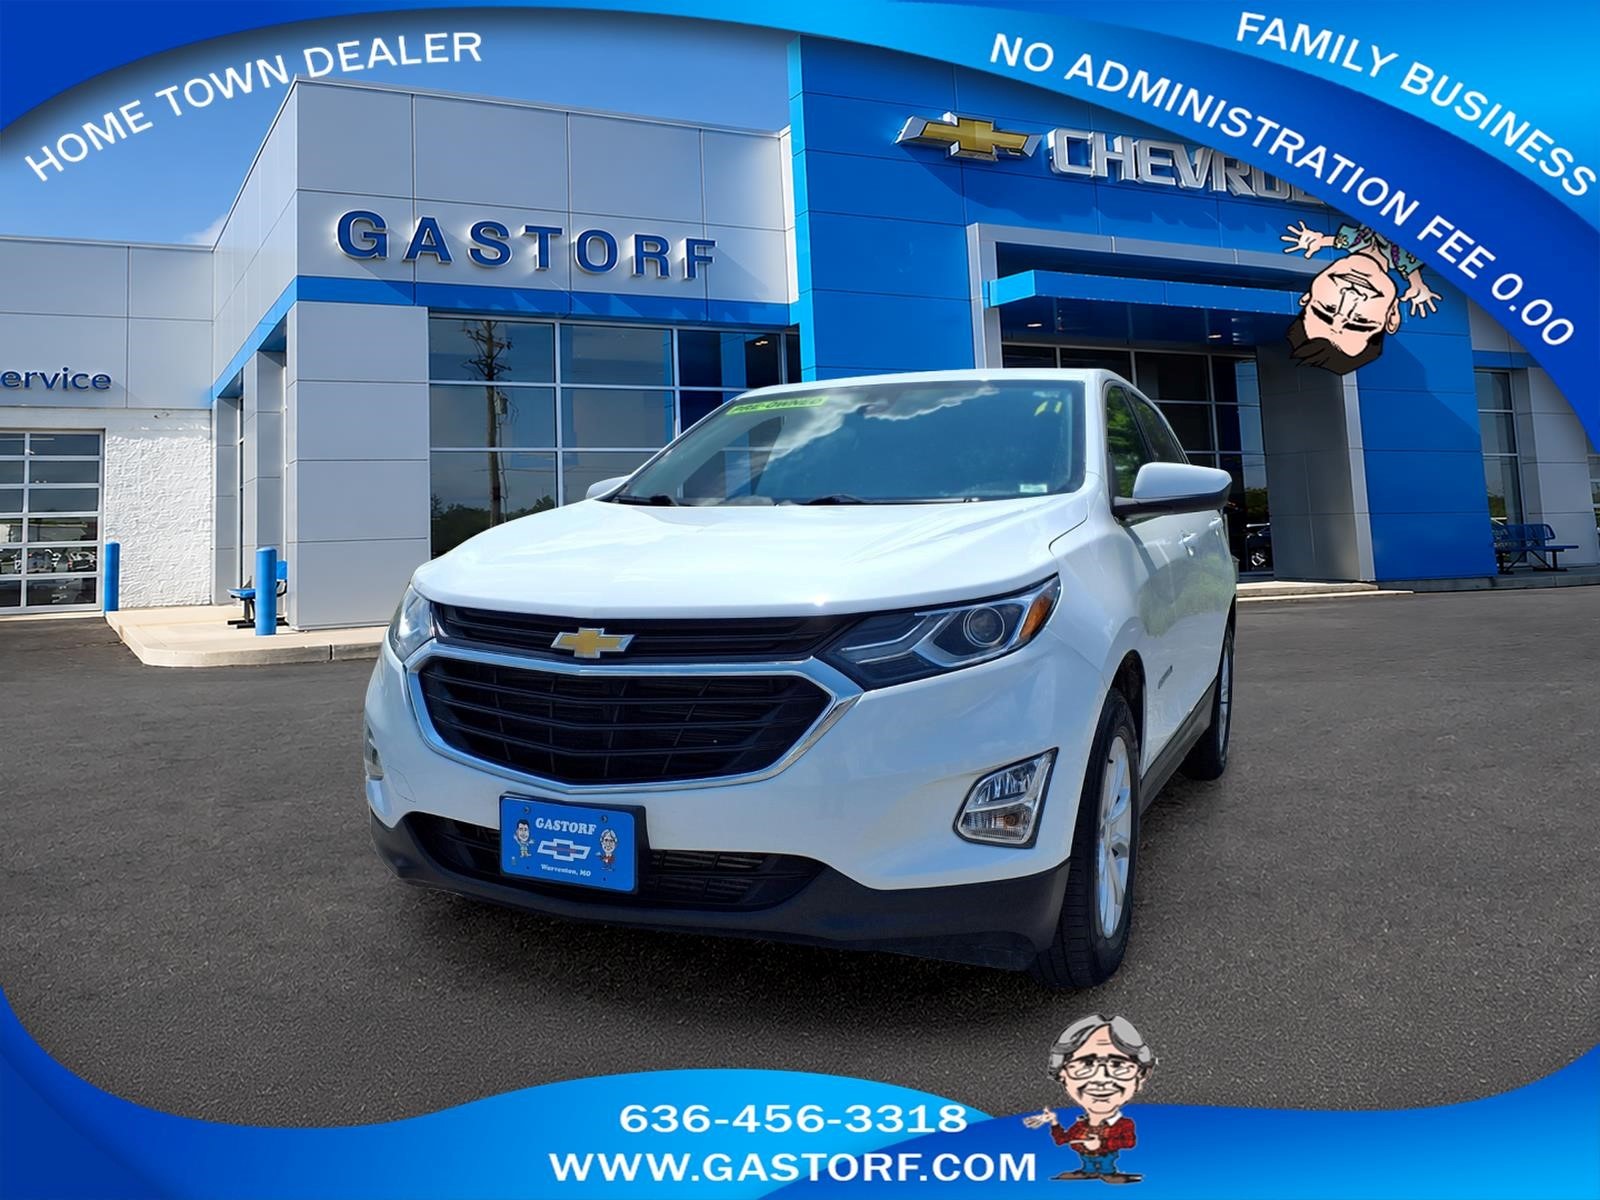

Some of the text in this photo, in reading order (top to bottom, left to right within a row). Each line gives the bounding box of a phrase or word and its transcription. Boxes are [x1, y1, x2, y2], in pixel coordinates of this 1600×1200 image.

[334, 208, 718, 281] GASTORF
[732, 398, 826, 412] PRE-OWNED
[535, 817, 597, 835] GASTORF
